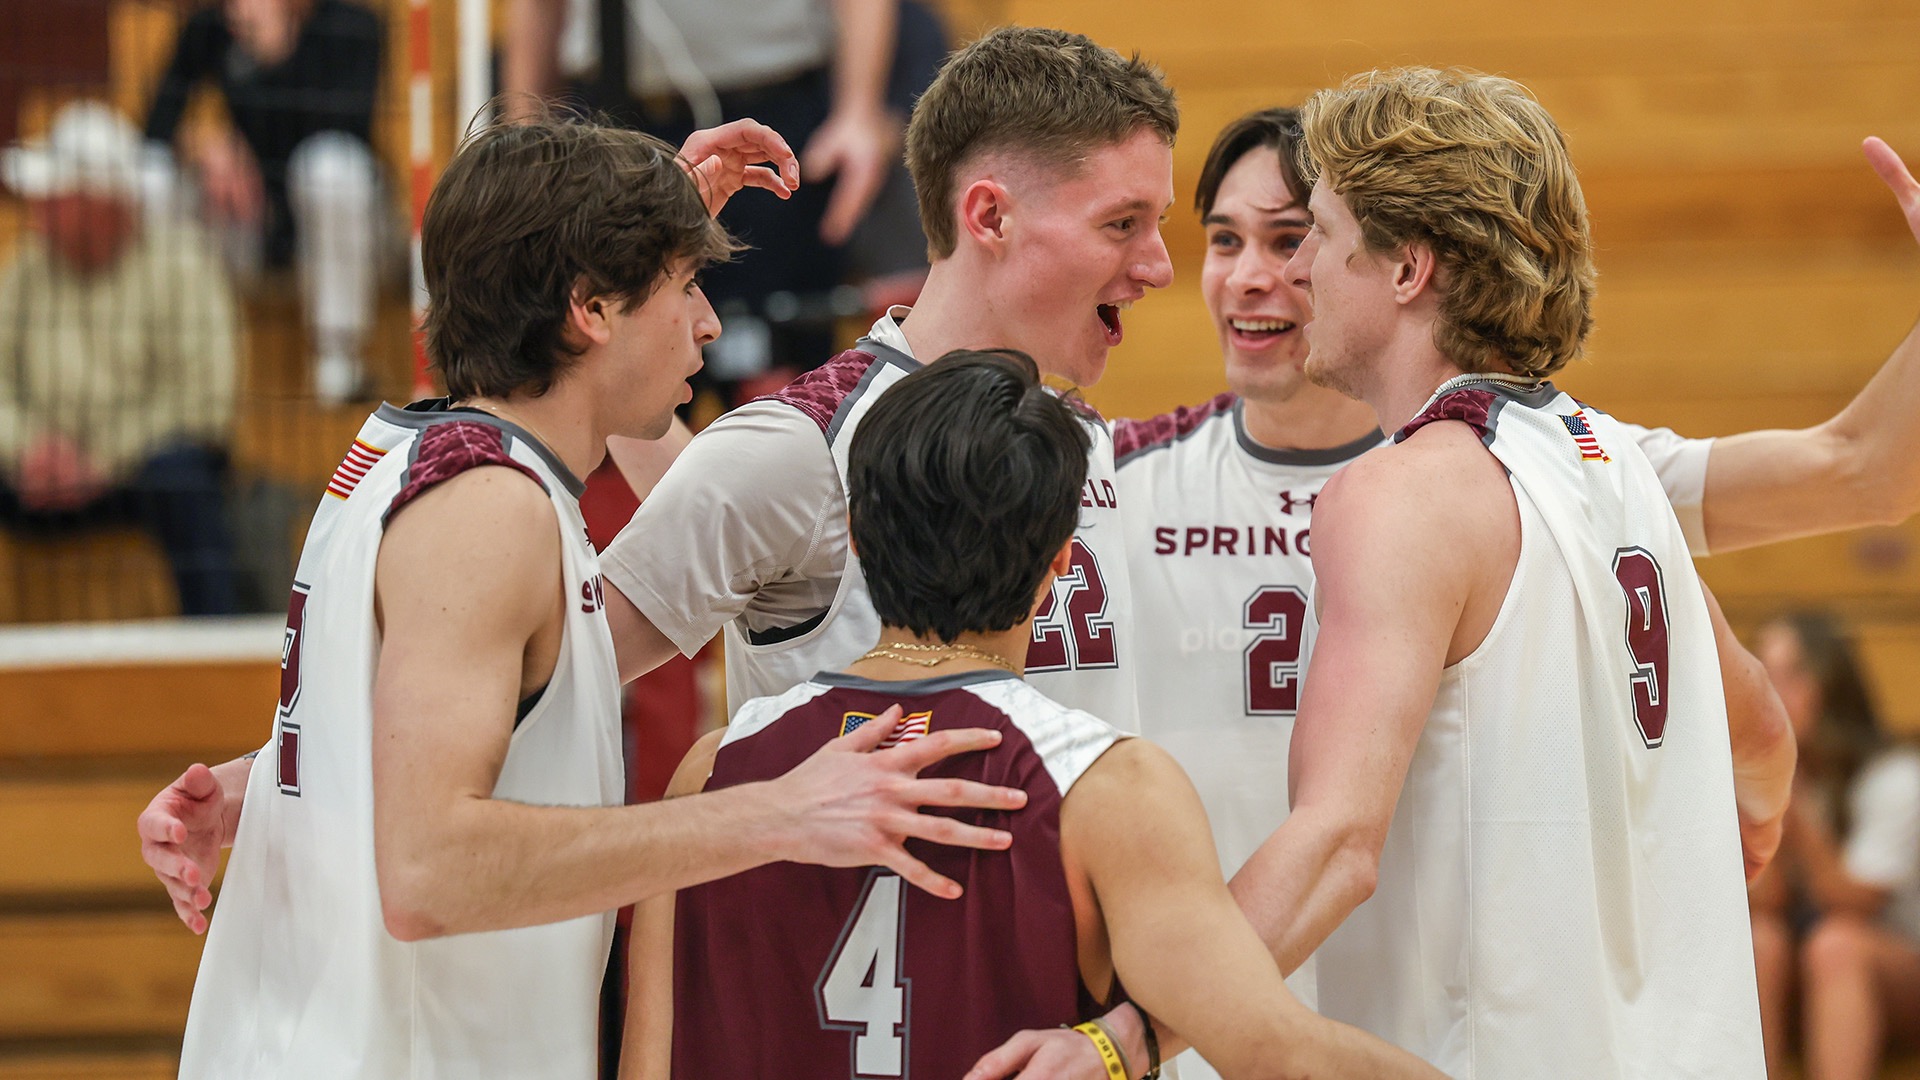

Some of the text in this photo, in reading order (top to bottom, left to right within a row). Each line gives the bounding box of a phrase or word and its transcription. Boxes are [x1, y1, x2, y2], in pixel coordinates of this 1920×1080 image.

[1243, 585, 1308, 717] 2
[1612, 545, 1671, 749] 9
[813, 867, 912, 1080] 4
[1098, 1038, 1113, 1058] LBC
